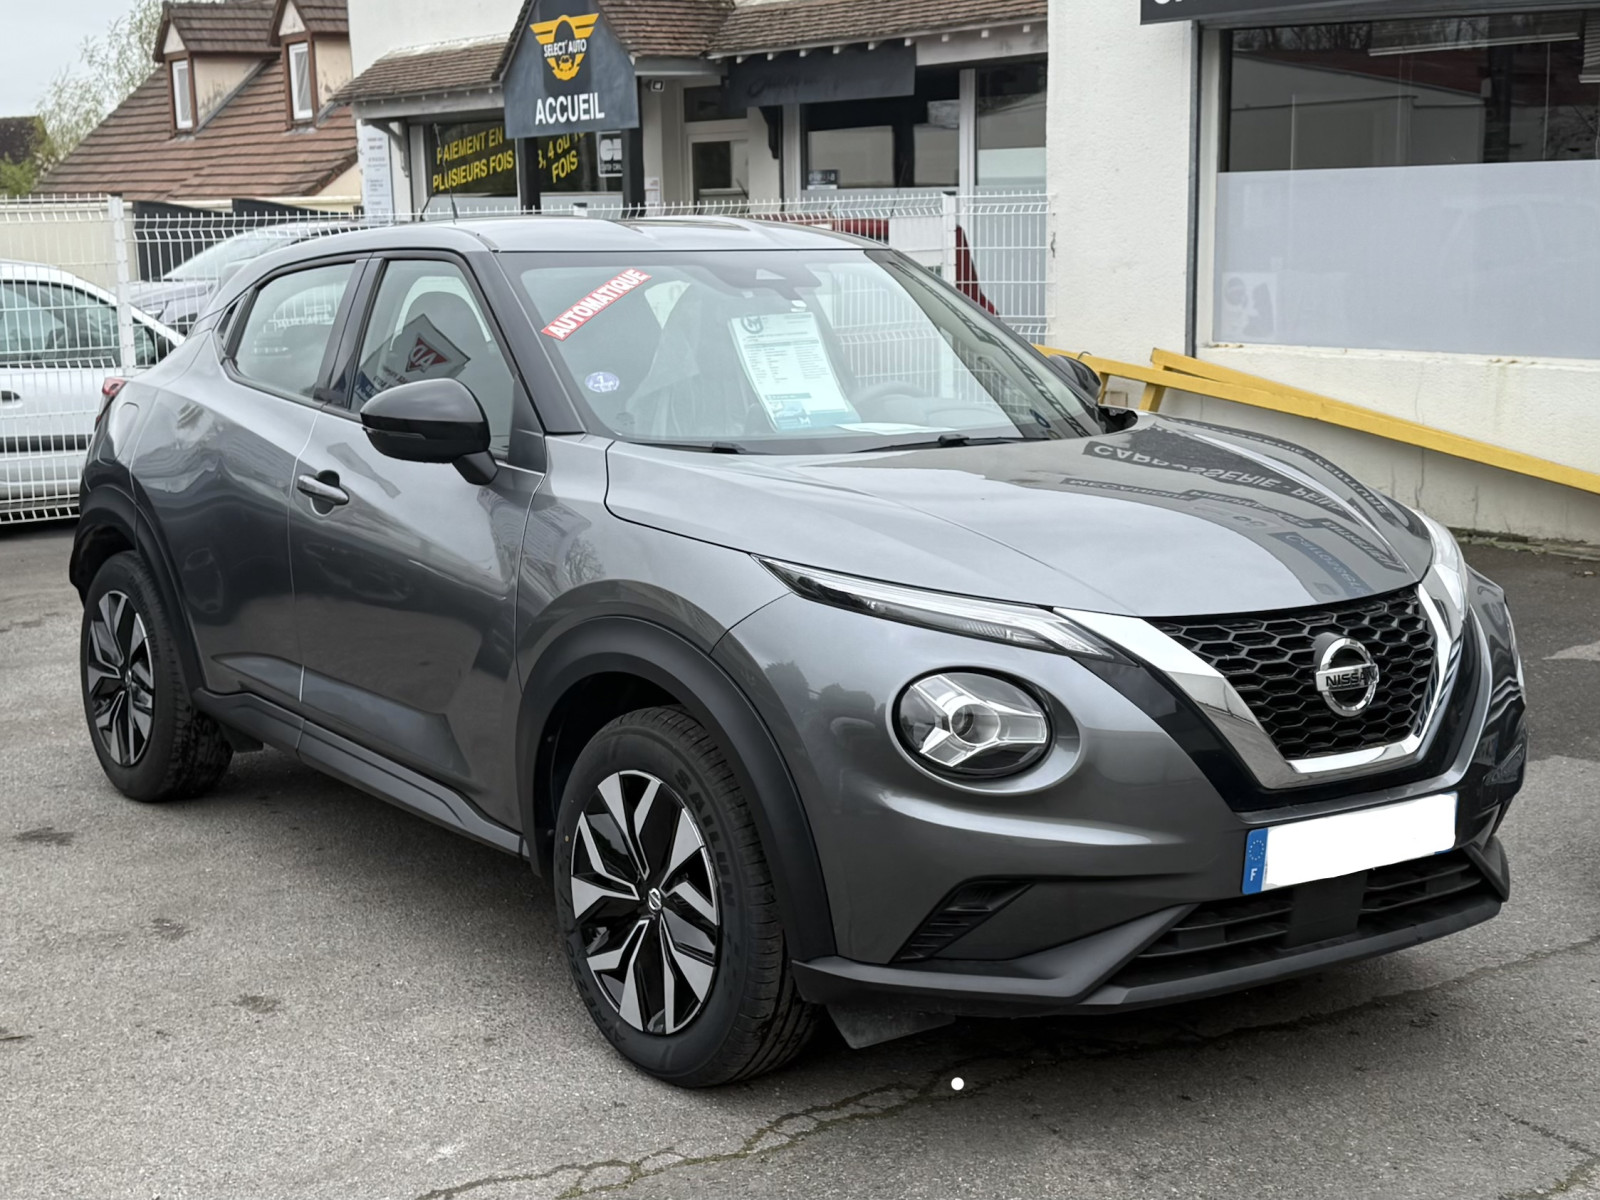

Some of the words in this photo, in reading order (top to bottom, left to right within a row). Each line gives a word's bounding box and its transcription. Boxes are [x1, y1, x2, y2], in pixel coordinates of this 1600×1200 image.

[535, 92, 605, 125] ACCUEIL
[437, 131, 487, 165] PAIEMENT
[489, 126, 503, 148] EN
[547, 140, 554, 159] 4
[433, 158, 488, 192] PLUSIEURS
[489, 150, 514, 174] FOIS
[552, 150, 578, 183] FOIS
[548, 268, 648, 339] AUTOMATIQUE
[1325, 667, 1377, 688] NISSAN
[674, 768, 736, 907] SAILUN
[1249, 867, 1257, 882] F
